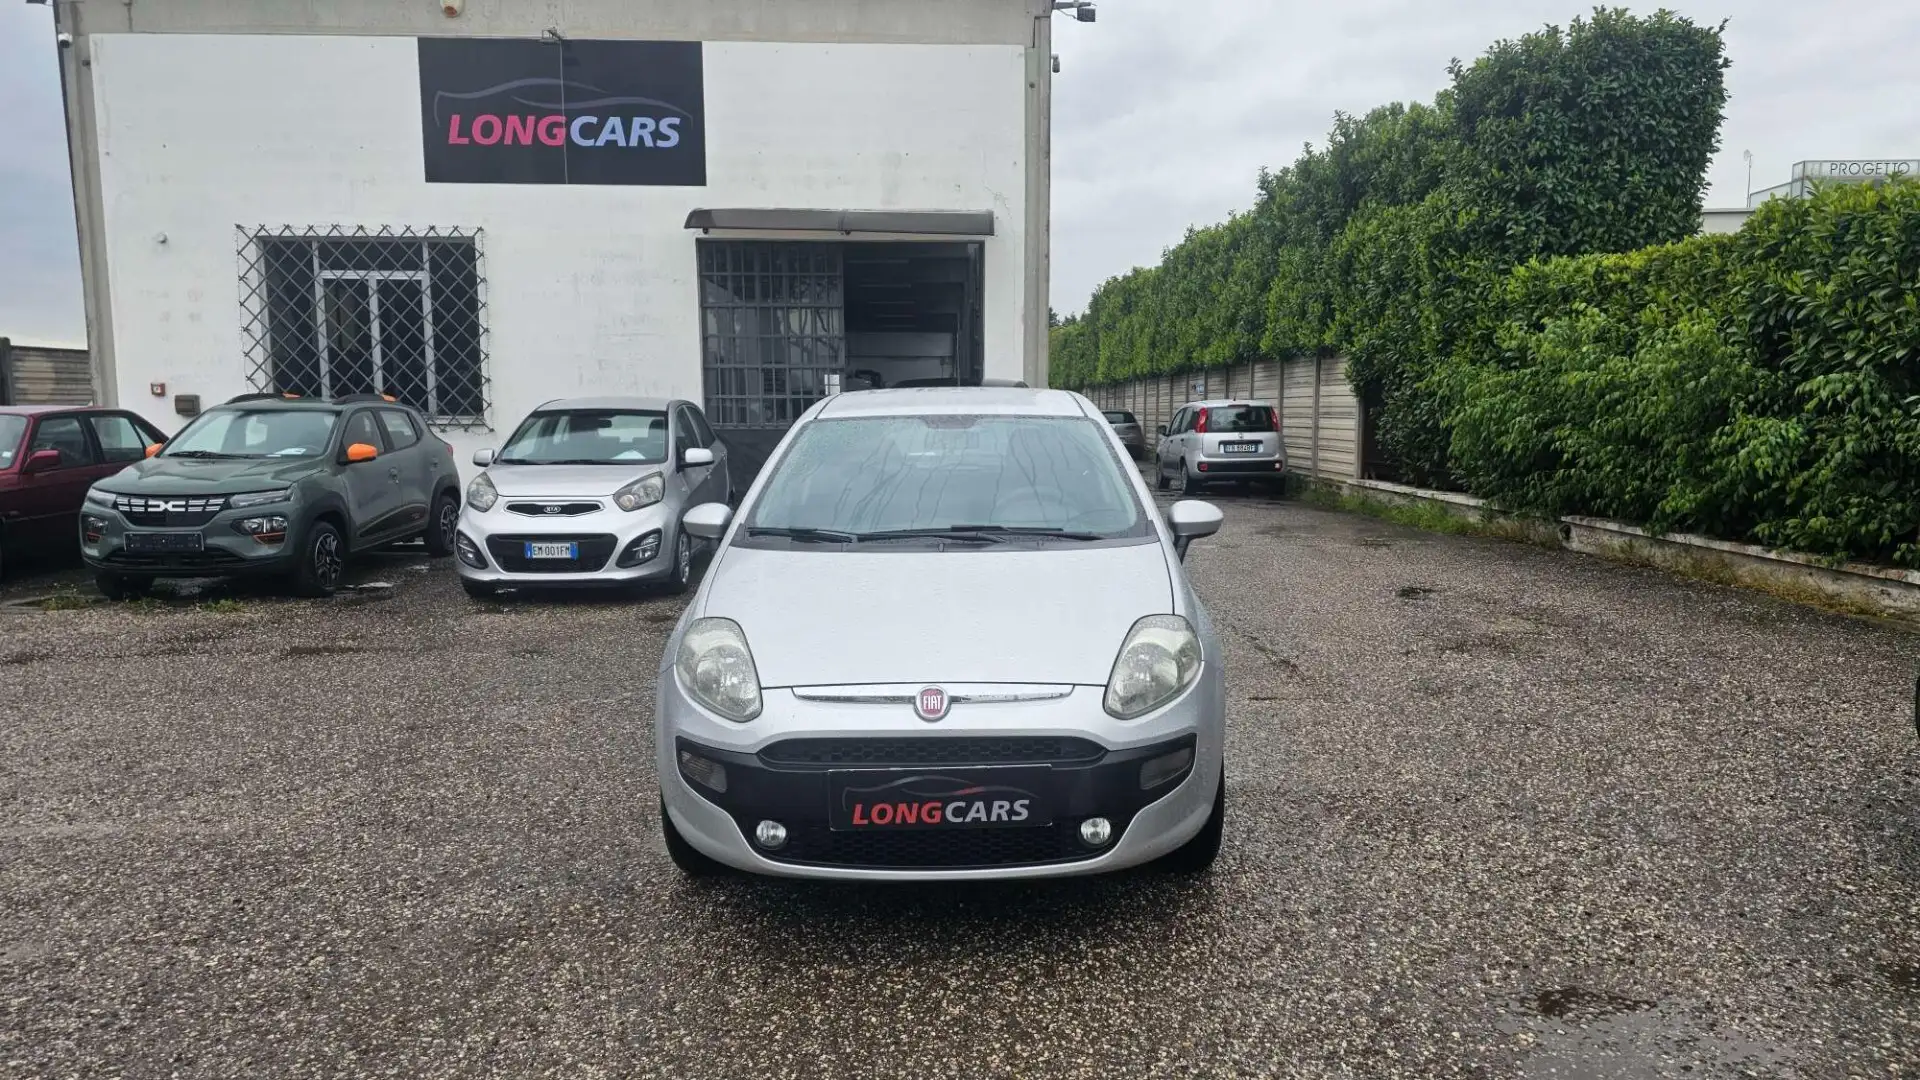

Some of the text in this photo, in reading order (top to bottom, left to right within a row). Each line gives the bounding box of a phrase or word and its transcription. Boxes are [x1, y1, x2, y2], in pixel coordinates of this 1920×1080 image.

[448, 114, 681, 148] LONGCARS
[1829, 161, 1911, 176] PROGETTO
[532, 545, 543, 556] EM
[923, 694, 942, 710] FIAT
[852, 799, 1030, 825] LONGCARS
